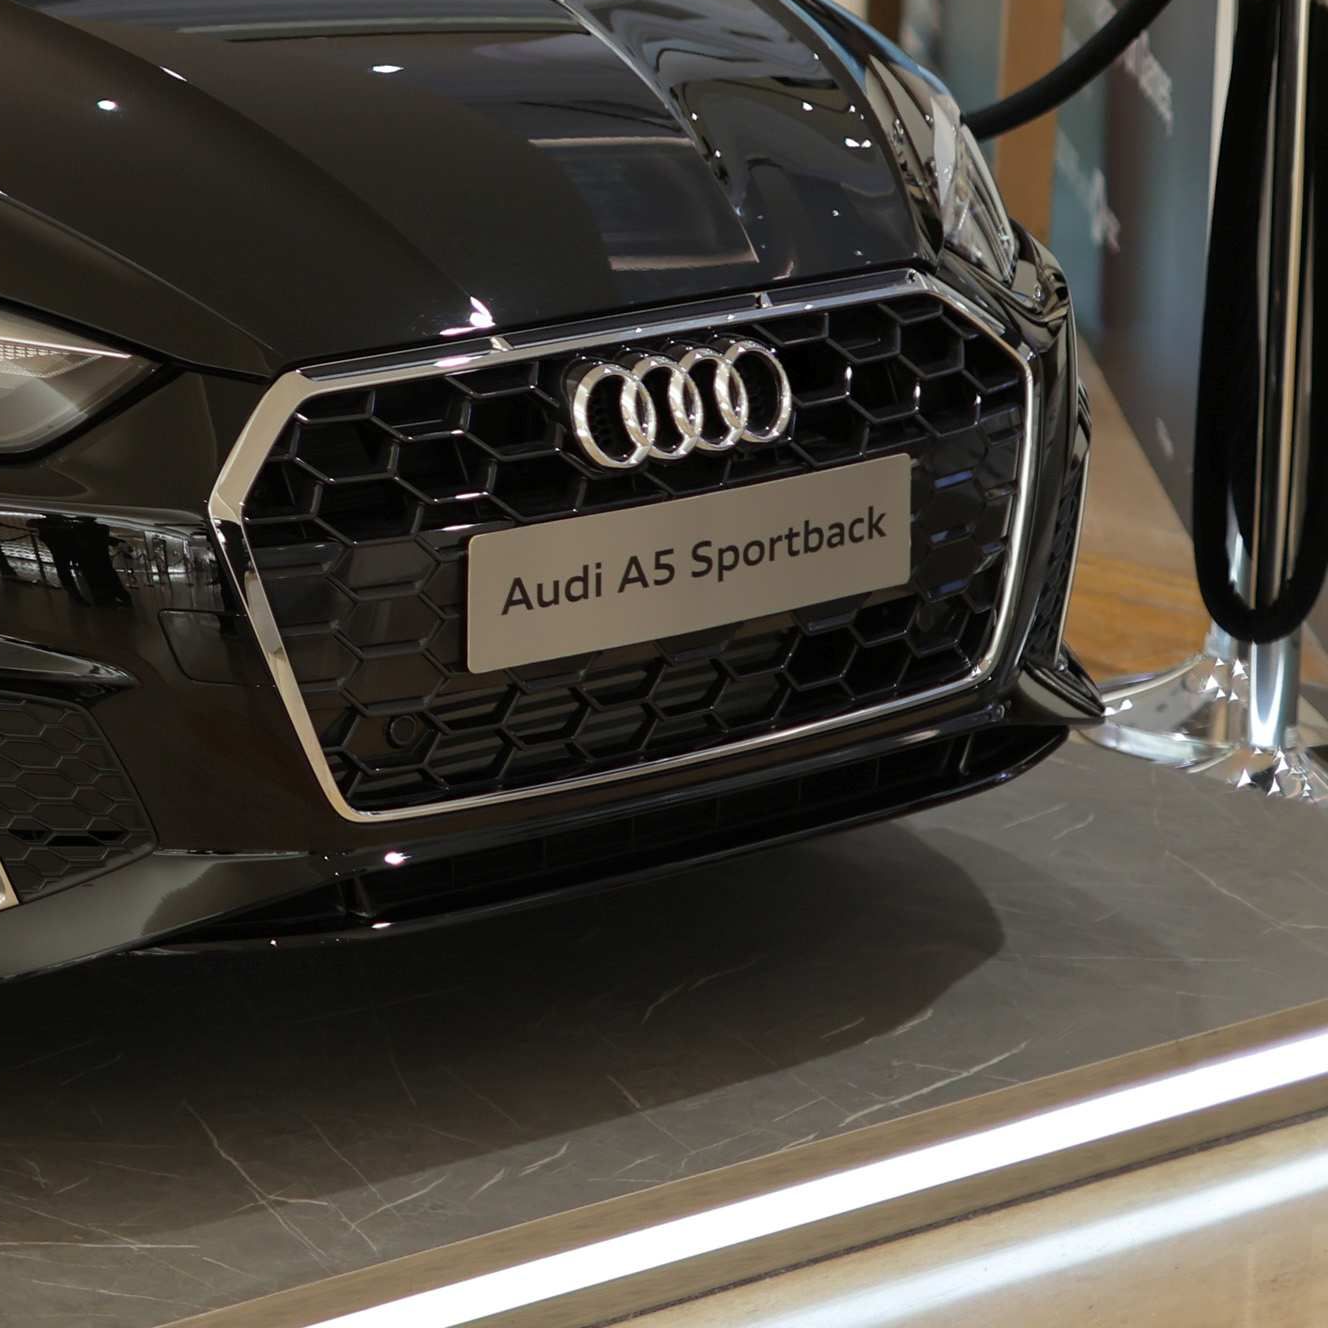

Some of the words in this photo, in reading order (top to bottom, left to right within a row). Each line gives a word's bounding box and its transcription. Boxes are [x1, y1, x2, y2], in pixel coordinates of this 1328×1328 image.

[501, 562, 603, 616] Audi
[617, 548, 676, 594] A5
[691, 505, 887, 582] Sportback
